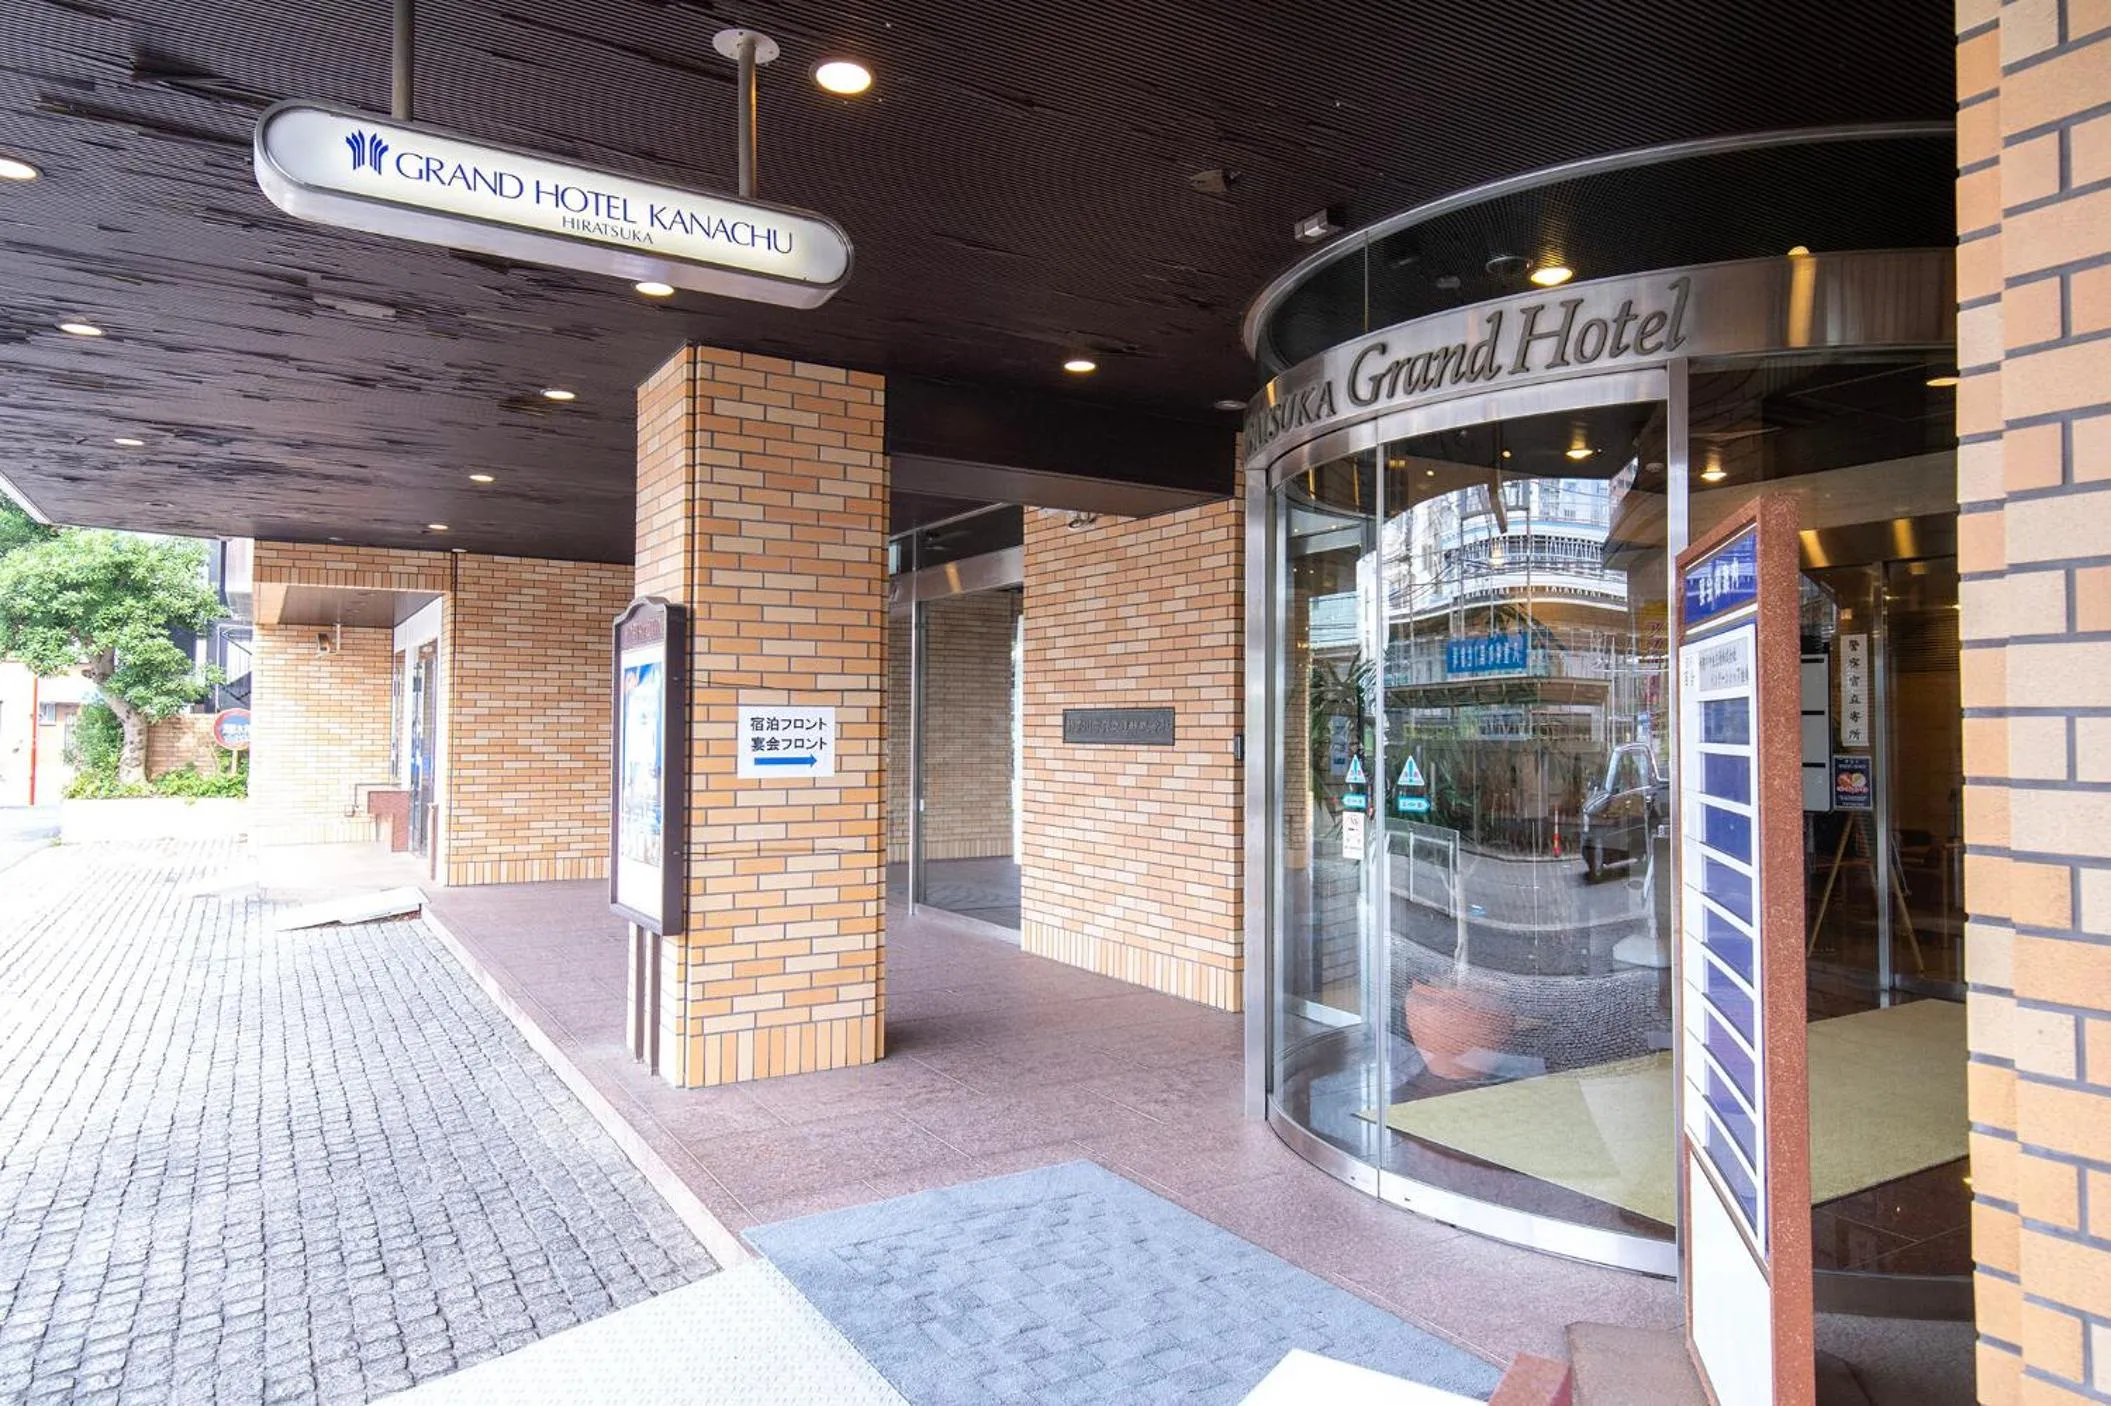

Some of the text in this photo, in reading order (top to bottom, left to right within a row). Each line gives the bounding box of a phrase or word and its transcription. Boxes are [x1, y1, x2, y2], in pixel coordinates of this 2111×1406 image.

[395, 152, 794, 255] GRAND HOTEL KANACHU
[561, 214, 654, 246] HIRATSUKA
[1347, 310, 1503, 407] Grand
[1508, 276, 1692, 376] Hotel
[750, 716, 827, 731] 宿泊フロント
[751, 736, 828, 751] 宴会フロント
